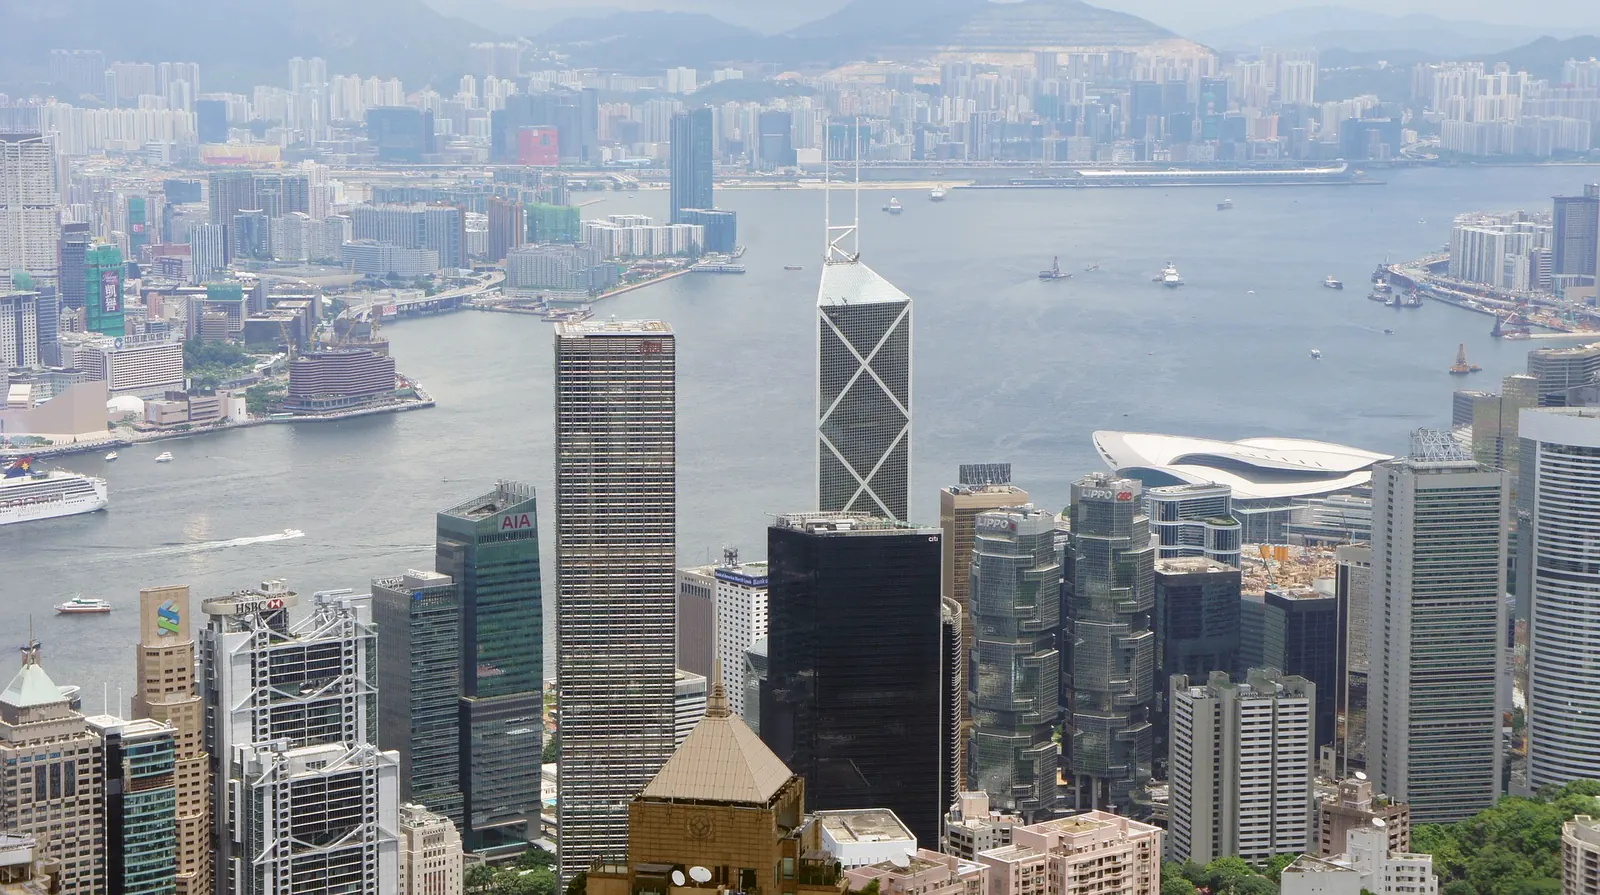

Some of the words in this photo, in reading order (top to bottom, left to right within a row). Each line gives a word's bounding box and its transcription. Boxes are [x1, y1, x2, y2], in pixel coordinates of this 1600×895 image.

[1081, 489, 1112, 500] LIPPO
[502, 514, 531, 530] AIA
[977, 517, 1009, 529] LIPPO
[236, 600, 267, 614] HSBC
